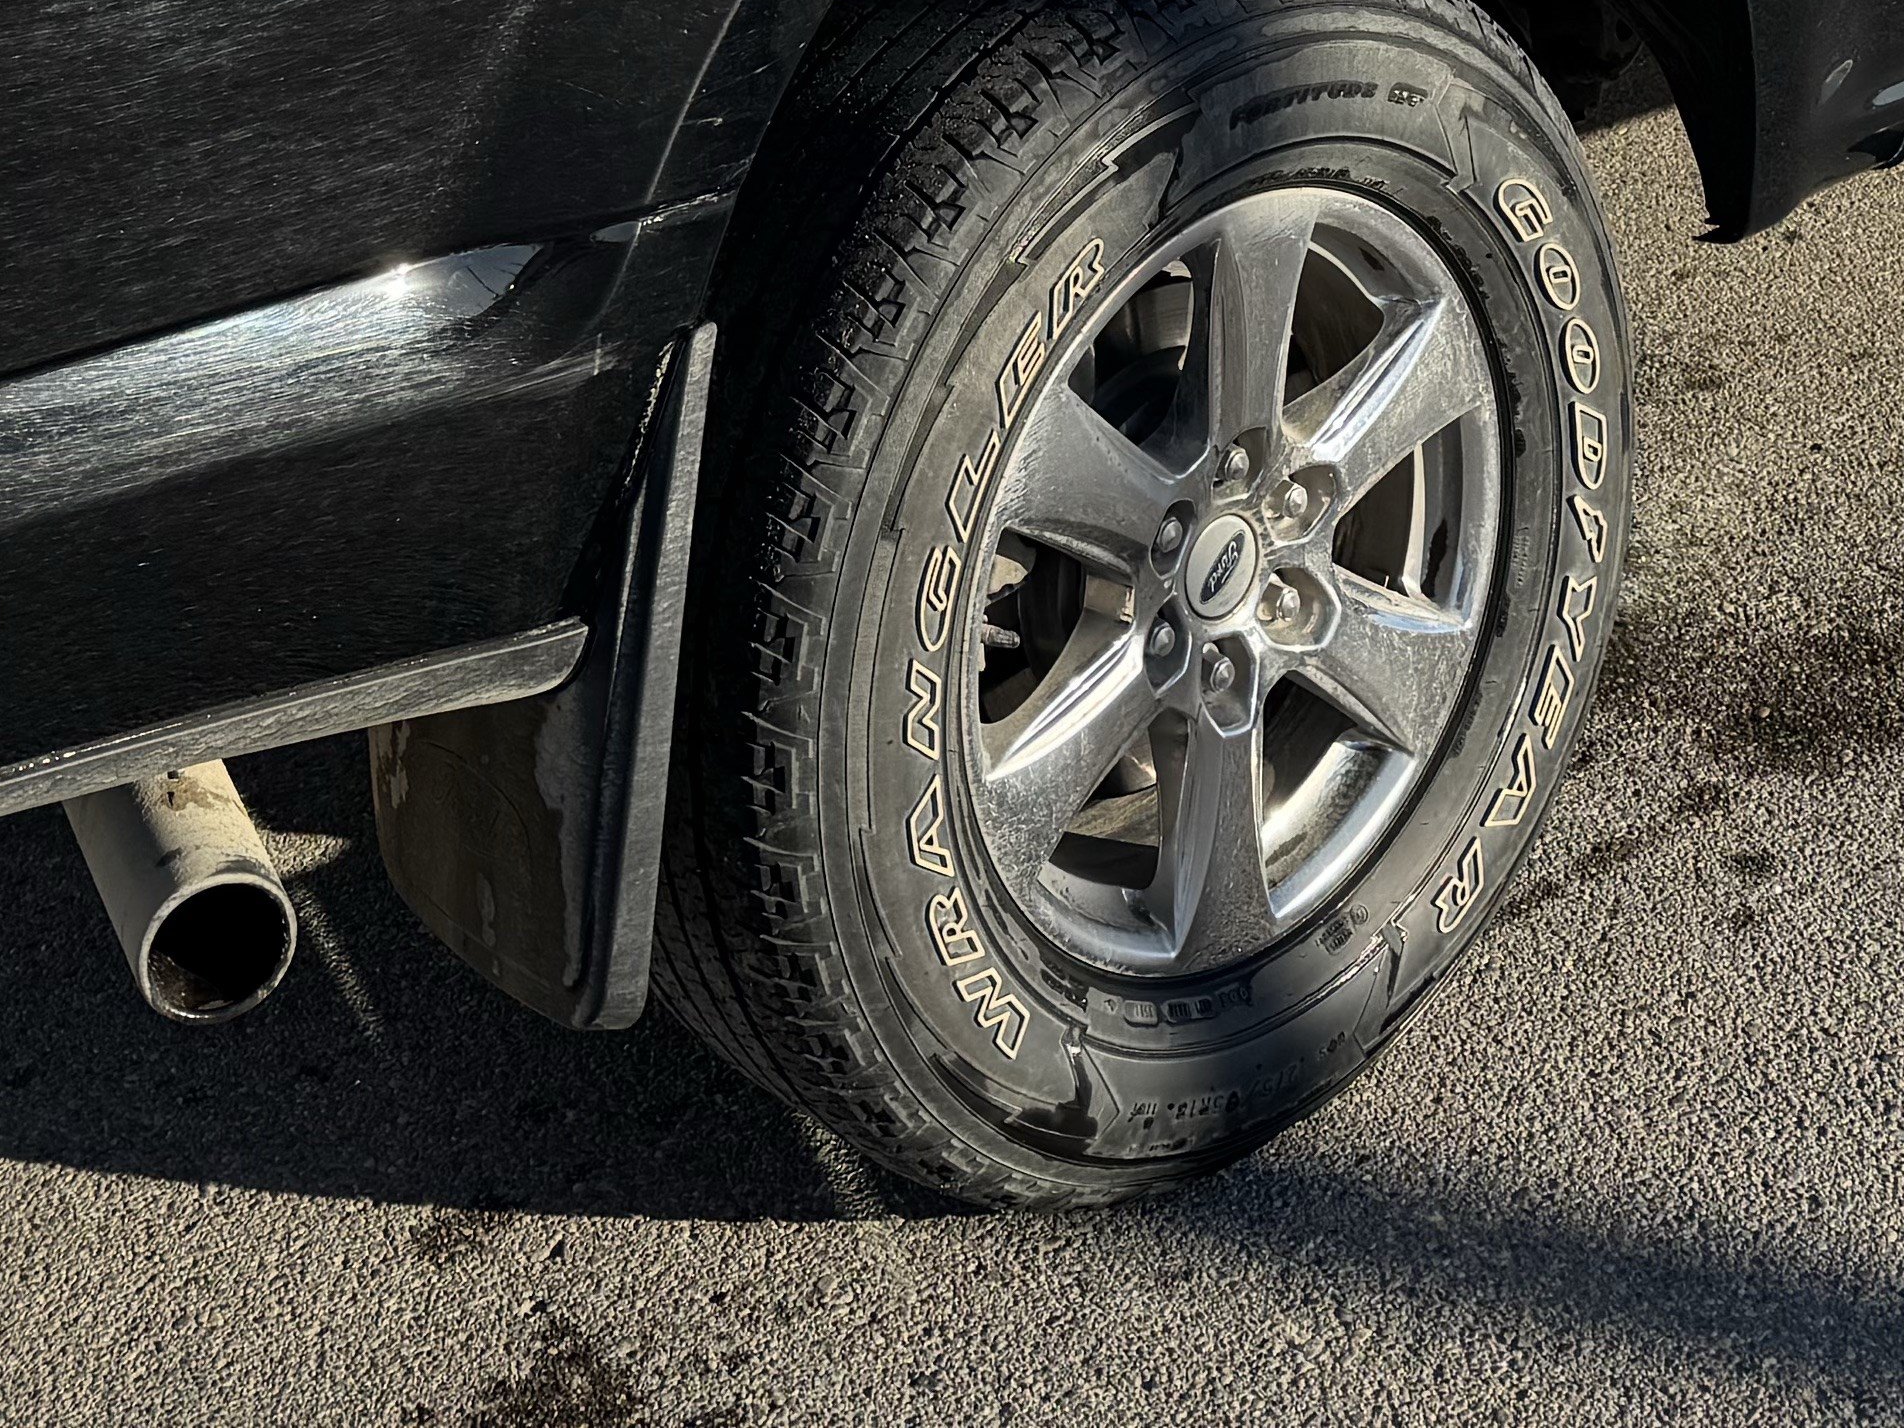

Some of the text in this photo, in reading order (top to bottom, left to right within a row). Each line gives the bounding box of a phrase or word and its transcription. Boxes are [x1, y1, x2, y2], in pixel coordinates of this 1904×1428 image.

[905, 236, 1107, 1061] WRANGLER
[1208, 540, 1239, 593] Ford
[1435, 177, 1612, 935] GOODYEAR
